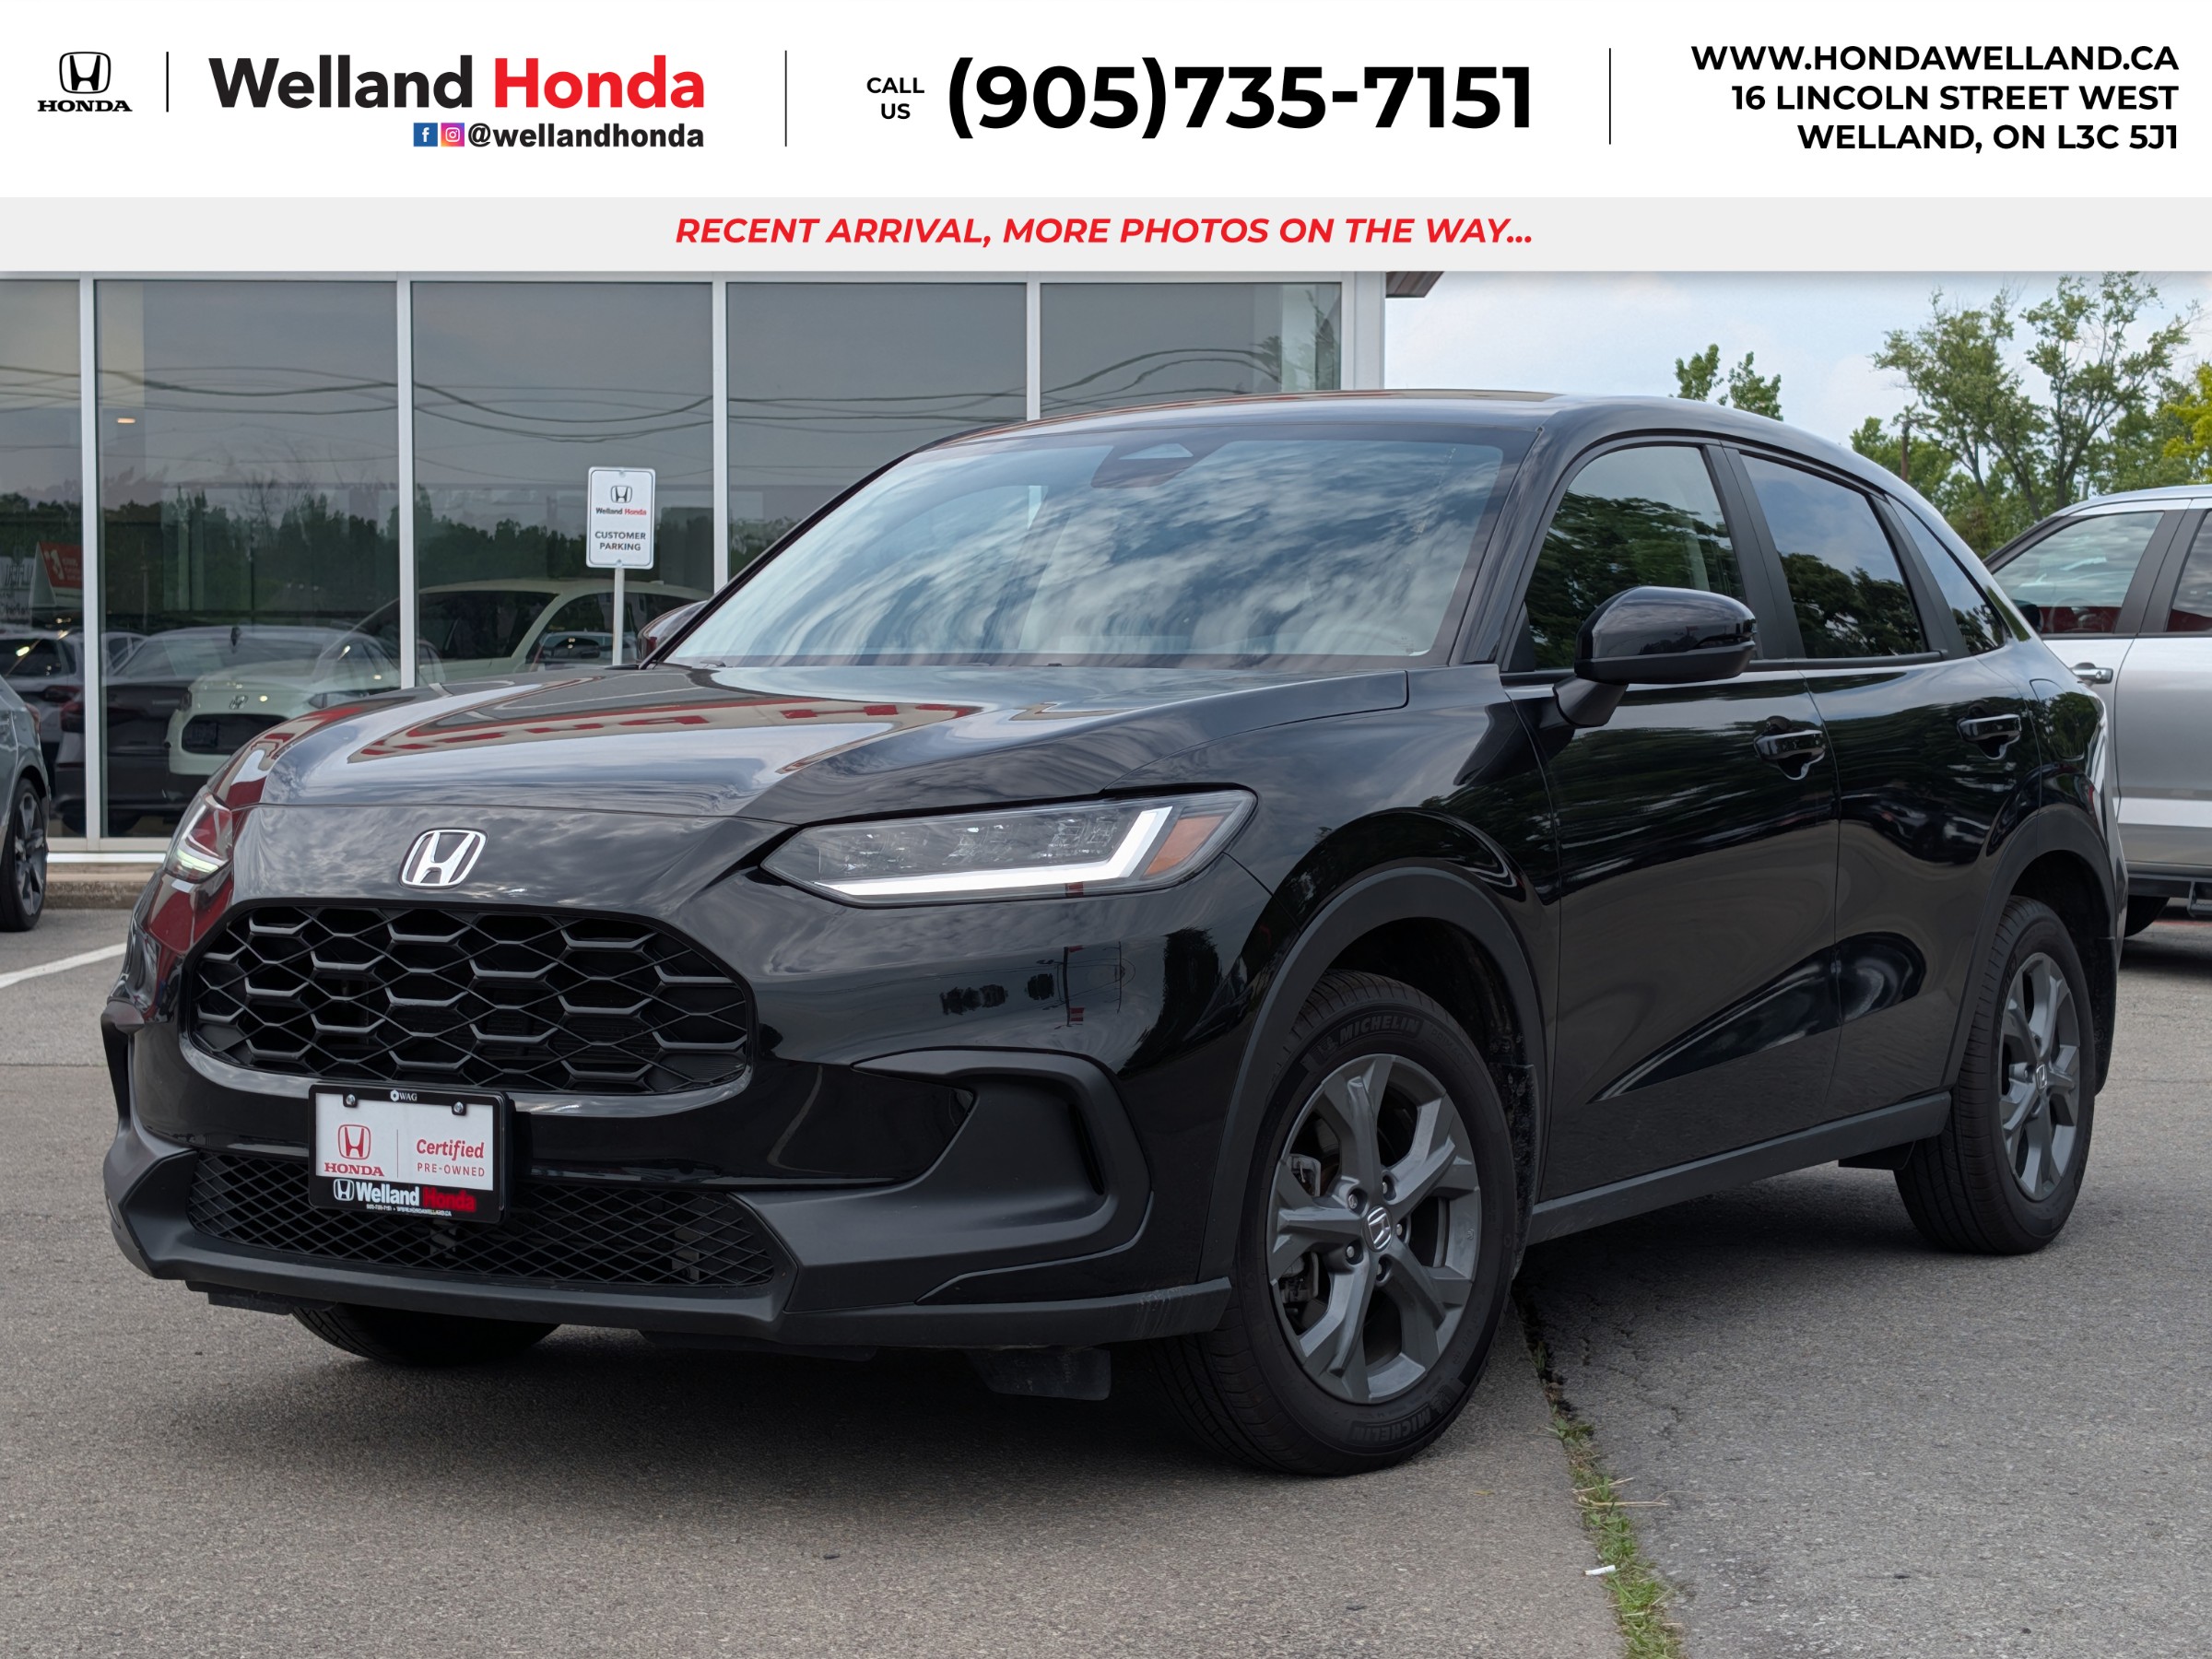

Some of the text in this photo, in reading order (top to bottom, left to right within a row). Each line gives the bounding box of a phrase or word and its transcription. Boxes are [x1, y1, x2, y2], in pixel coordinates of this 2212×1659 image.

[595, 507, 647, 516] Welland Honda
[594, 531, 647, 540] CUSTOMER
[599, 542, 641, 551] PARKING
[1339, 1015, 1419, 1045] MICHELIN
[399, 1092, 418, 1102] WAG
[416, 1138, 485, 1161] Certified
[324, 1162, 385, 1177] HONDA
[417, 1162, 485, 1177] PRE-OWNED
[356, 1182, 477, 1213] Welland Honda
[1353, 1407, 1431, 1442] MICHELIN
